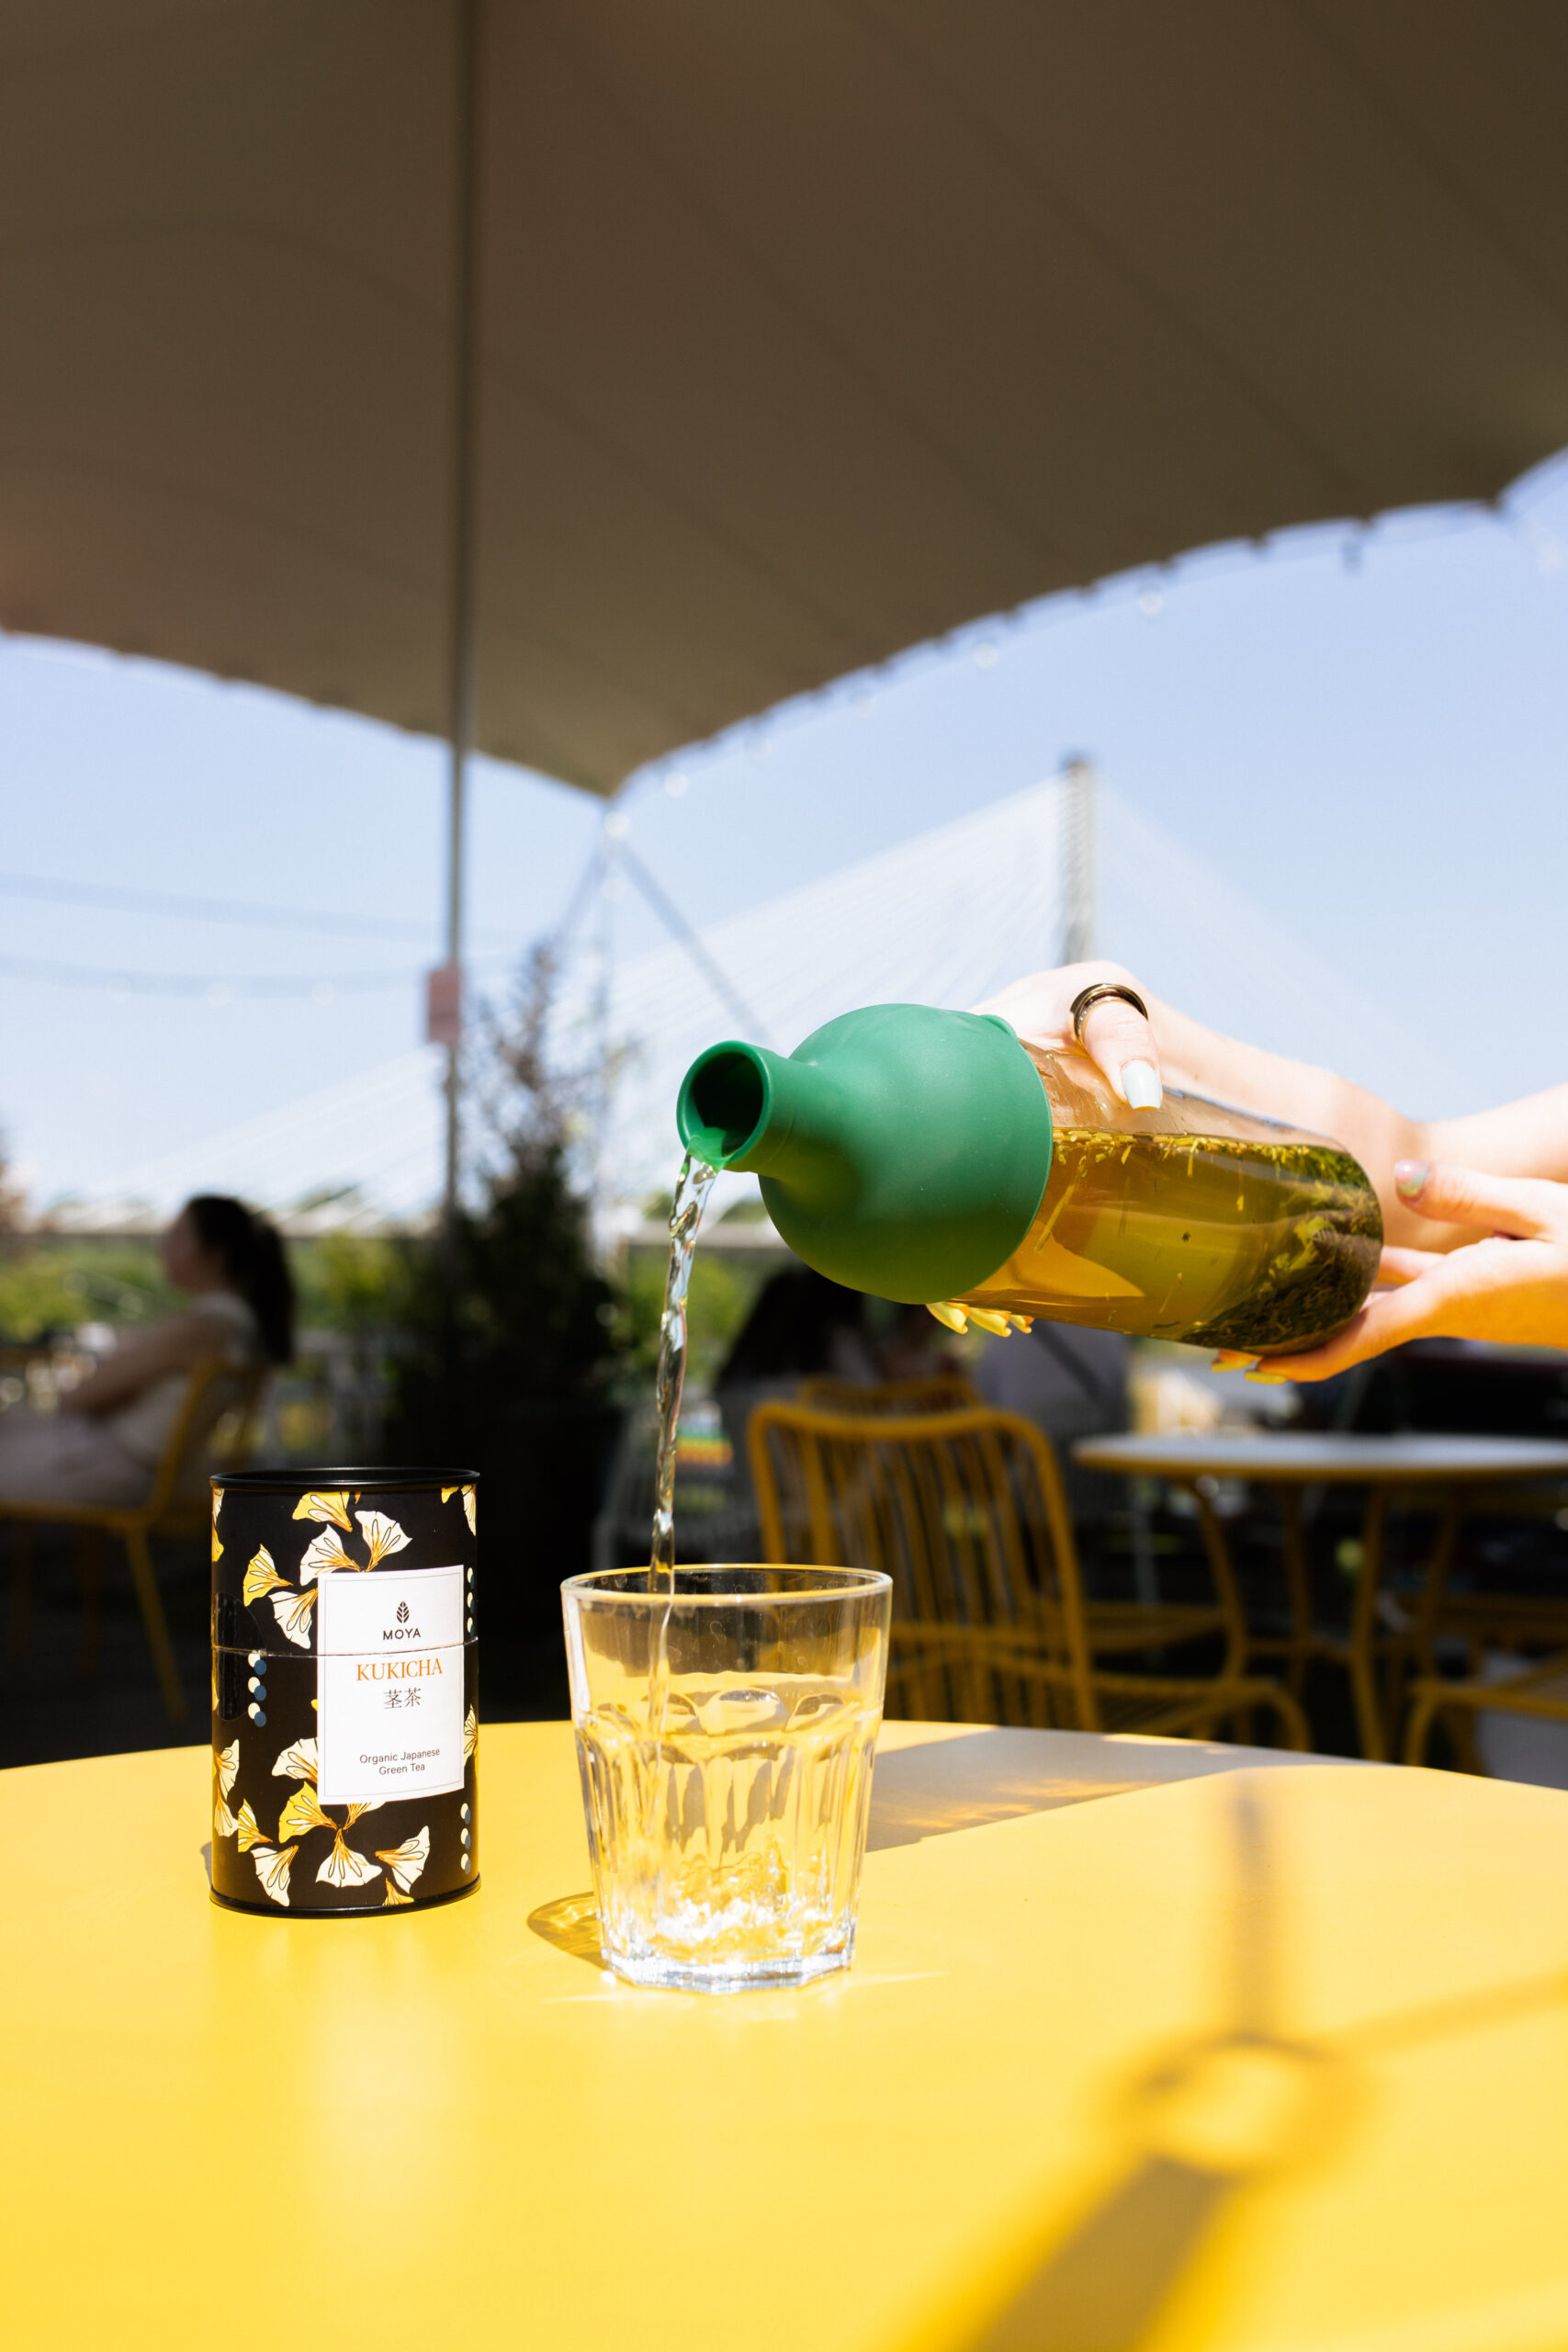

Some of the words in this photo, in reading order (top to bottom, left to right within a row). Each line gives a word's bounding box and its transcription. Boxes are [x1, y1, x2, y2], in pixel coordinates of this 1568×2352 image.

[382, 1628, 421, 1640] MOYA
[356, 1657, 443, 1680] KUKICHA
[383, 1687, 422, 1709] 茎茶
[359, 1753, 398, 1765] Organic
[400, 1748, 440, 1761] Japanese
[378, 1765, 408, 1776] Green
[410, 1762, 425, 1772] Tea
